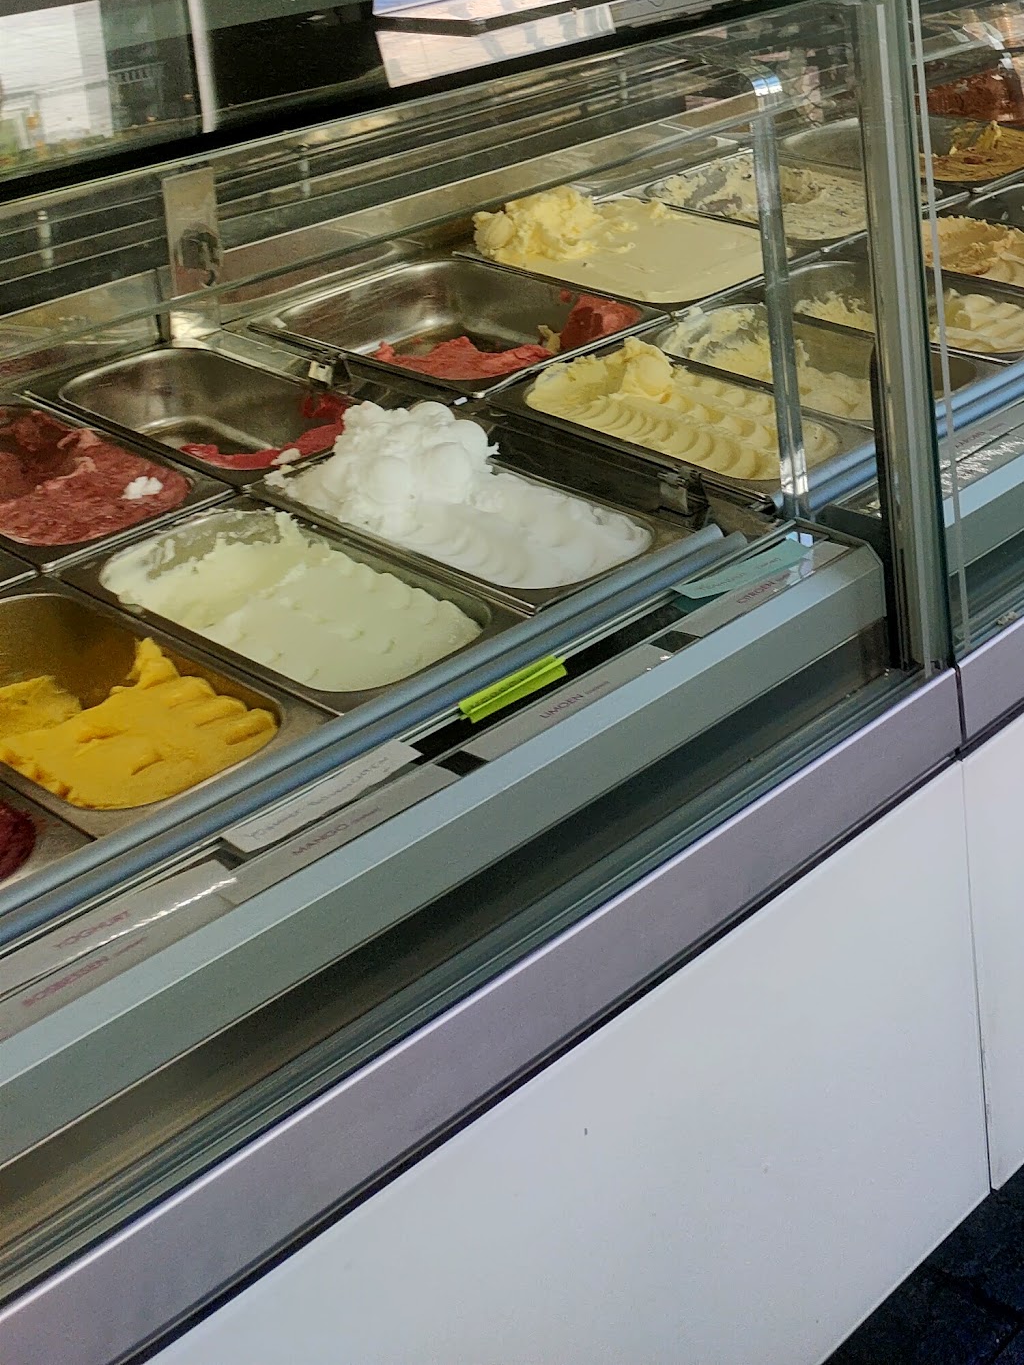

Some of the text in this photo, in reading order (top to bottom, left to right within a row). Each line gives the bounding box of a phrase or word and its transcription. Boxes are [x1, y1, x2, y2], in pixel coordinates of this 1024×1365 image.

[539, 693, 584, 719] LIMOEN
[292, 822, 348, 856] MANGO
[52, 909, 129, 949] YOGHURT
